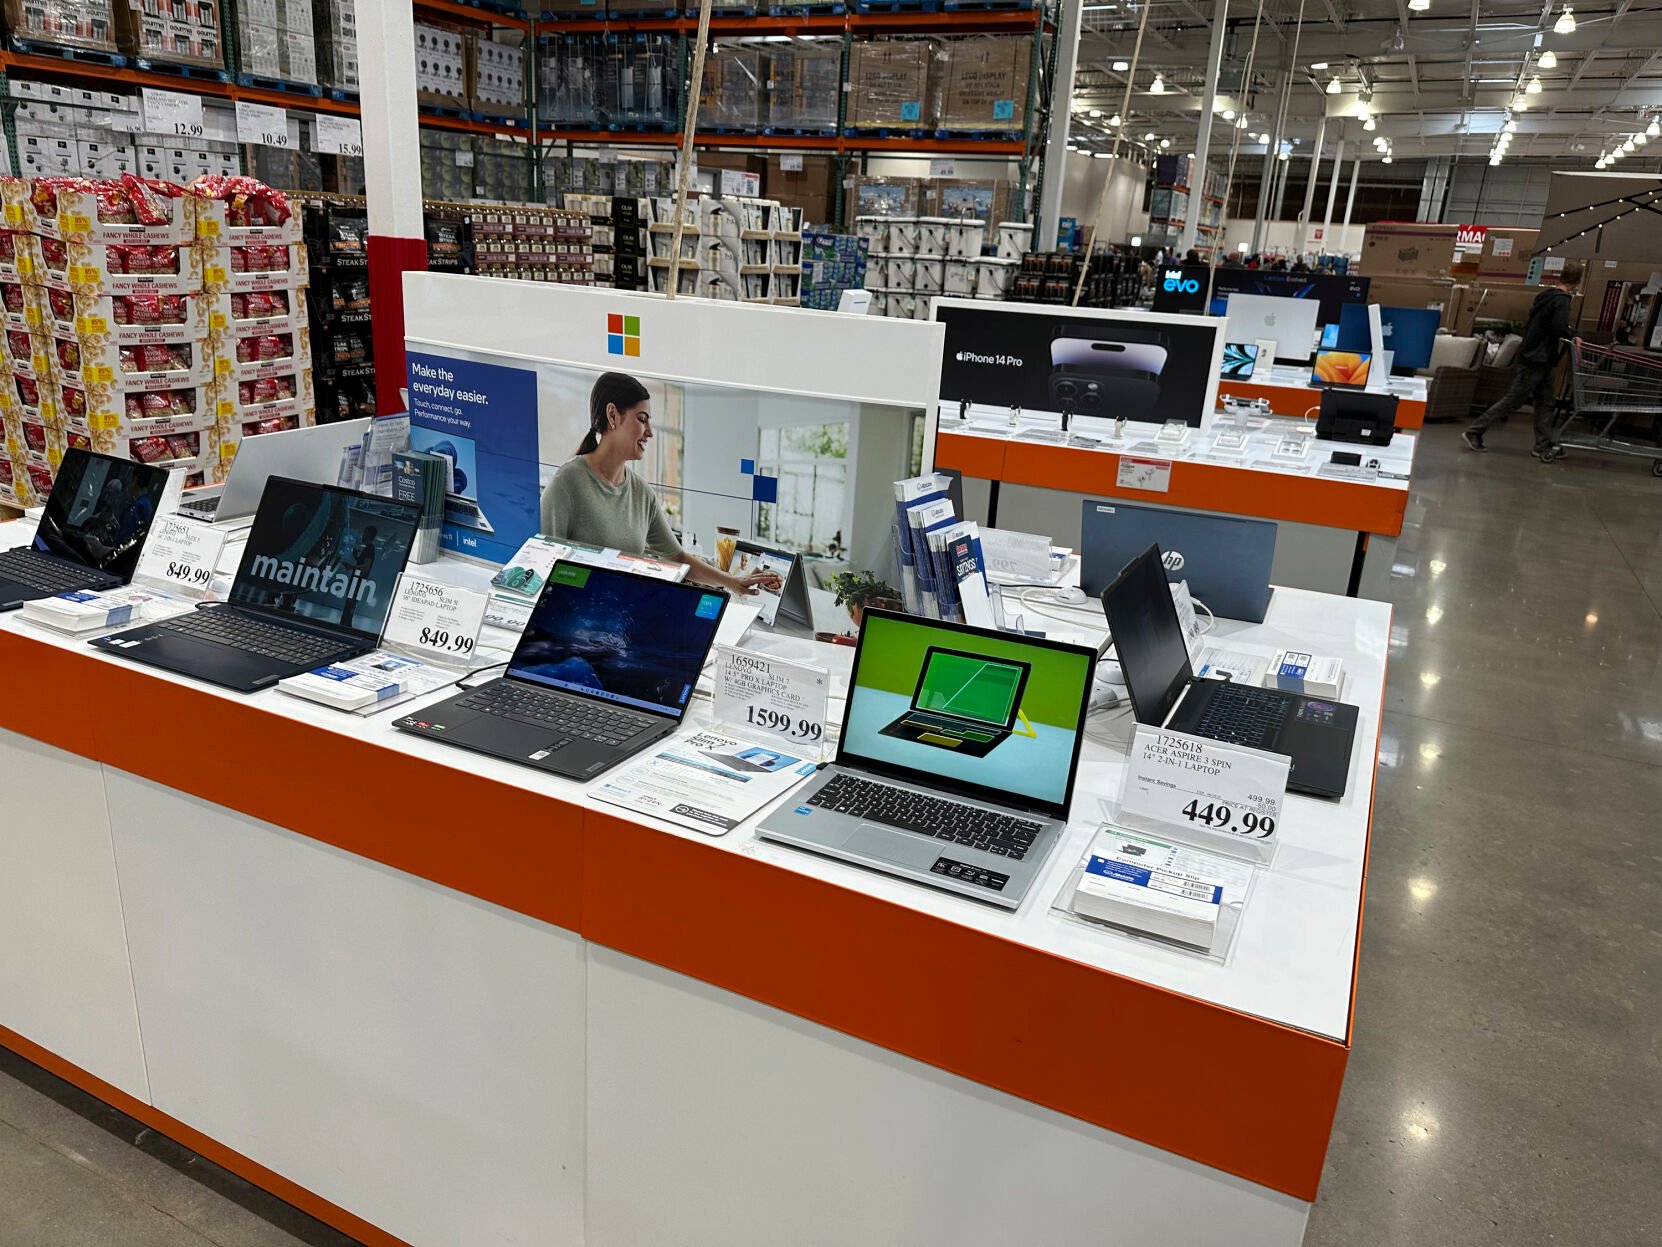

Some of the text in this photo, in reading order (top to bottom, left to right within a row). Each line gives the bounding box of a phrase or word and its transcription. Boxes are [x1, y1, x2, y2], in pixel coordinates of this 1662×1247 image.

[174, 123, 203, 136] 12.99
[261, 133, 287, 146] 10.49
[338, 143, 362, 155] 15.99
[336, 258, 359, 266] STEAK
[1163, 279, 1199, 293] evo
[341, 314, 364, 322] STEAK
[963, 351, 1023, 367] iPhone 14 Pro
[342, 368, 366, 377] STEAK
[412, 363, 454, 382] Make the
[413, 382, 489, 405] everyday easier.
[413, 398, 463, 416] Touch, connect, go.
[168, 420, 193, 428] CASHEWS
[414, 409, 471, 428] Performance your way.
[398, 490, 416, 502] FREE
[463, 535, 477, 548] intel
[1163, 552, 1183, 570] hp
[166, 561, 210, 585] 849.99
[250, 554, 377, 607] maintain
[404, 588, 427, 599] LENOVO
[411, 581, 444, 597] 1725656
[412, 597, 435, 607] IDEAPAD
[435, 601, 457, 612] LAPTOP
[419, 627, 474, 654] 849.99
[725, 661, 752, 674] LENOVO
[768, 673, 784, 683] SLIM
[731, 654, 771, 674] 1659421
[741, 673, 754, 682] PRO
[761, 678, 787, 690] LAPTOP
[734, 678, 746, 687] 4GB
[747, 681, 780, 697] GRAPHICS
[781, 689, 801, 702] CARD
[746, 705, 822, 741] 1599.99
[683, 739, 703, 747] Pro
[690, 736, 715, 745] Slim
[697, 732, 738, 746] Lenovo
[1156, 735, 1203, 754] 1725618
[1143, 752, 1221, 776] 14" 2-IN-1 LAPTOP
[1144, 744, 1168, 755] ACER
[1171, 750, 1202, 764] ASPIRE
[1211, 759, 1232, 770] SPIN
[1137, 775, 1176, 789] Instant Savings
[1248, 794, 1276, 806] 499.99
[1222, 800, 1239, 809] PRICE
[1248, 806, 1277, 818] REGISTER
[1181, 799, 1275, 839] 449.99
[1116, 856, 1155, 870] Computer
[1156, 866, 1184, 878] Pickup
[1185, 873, 1200, 881] Slip
